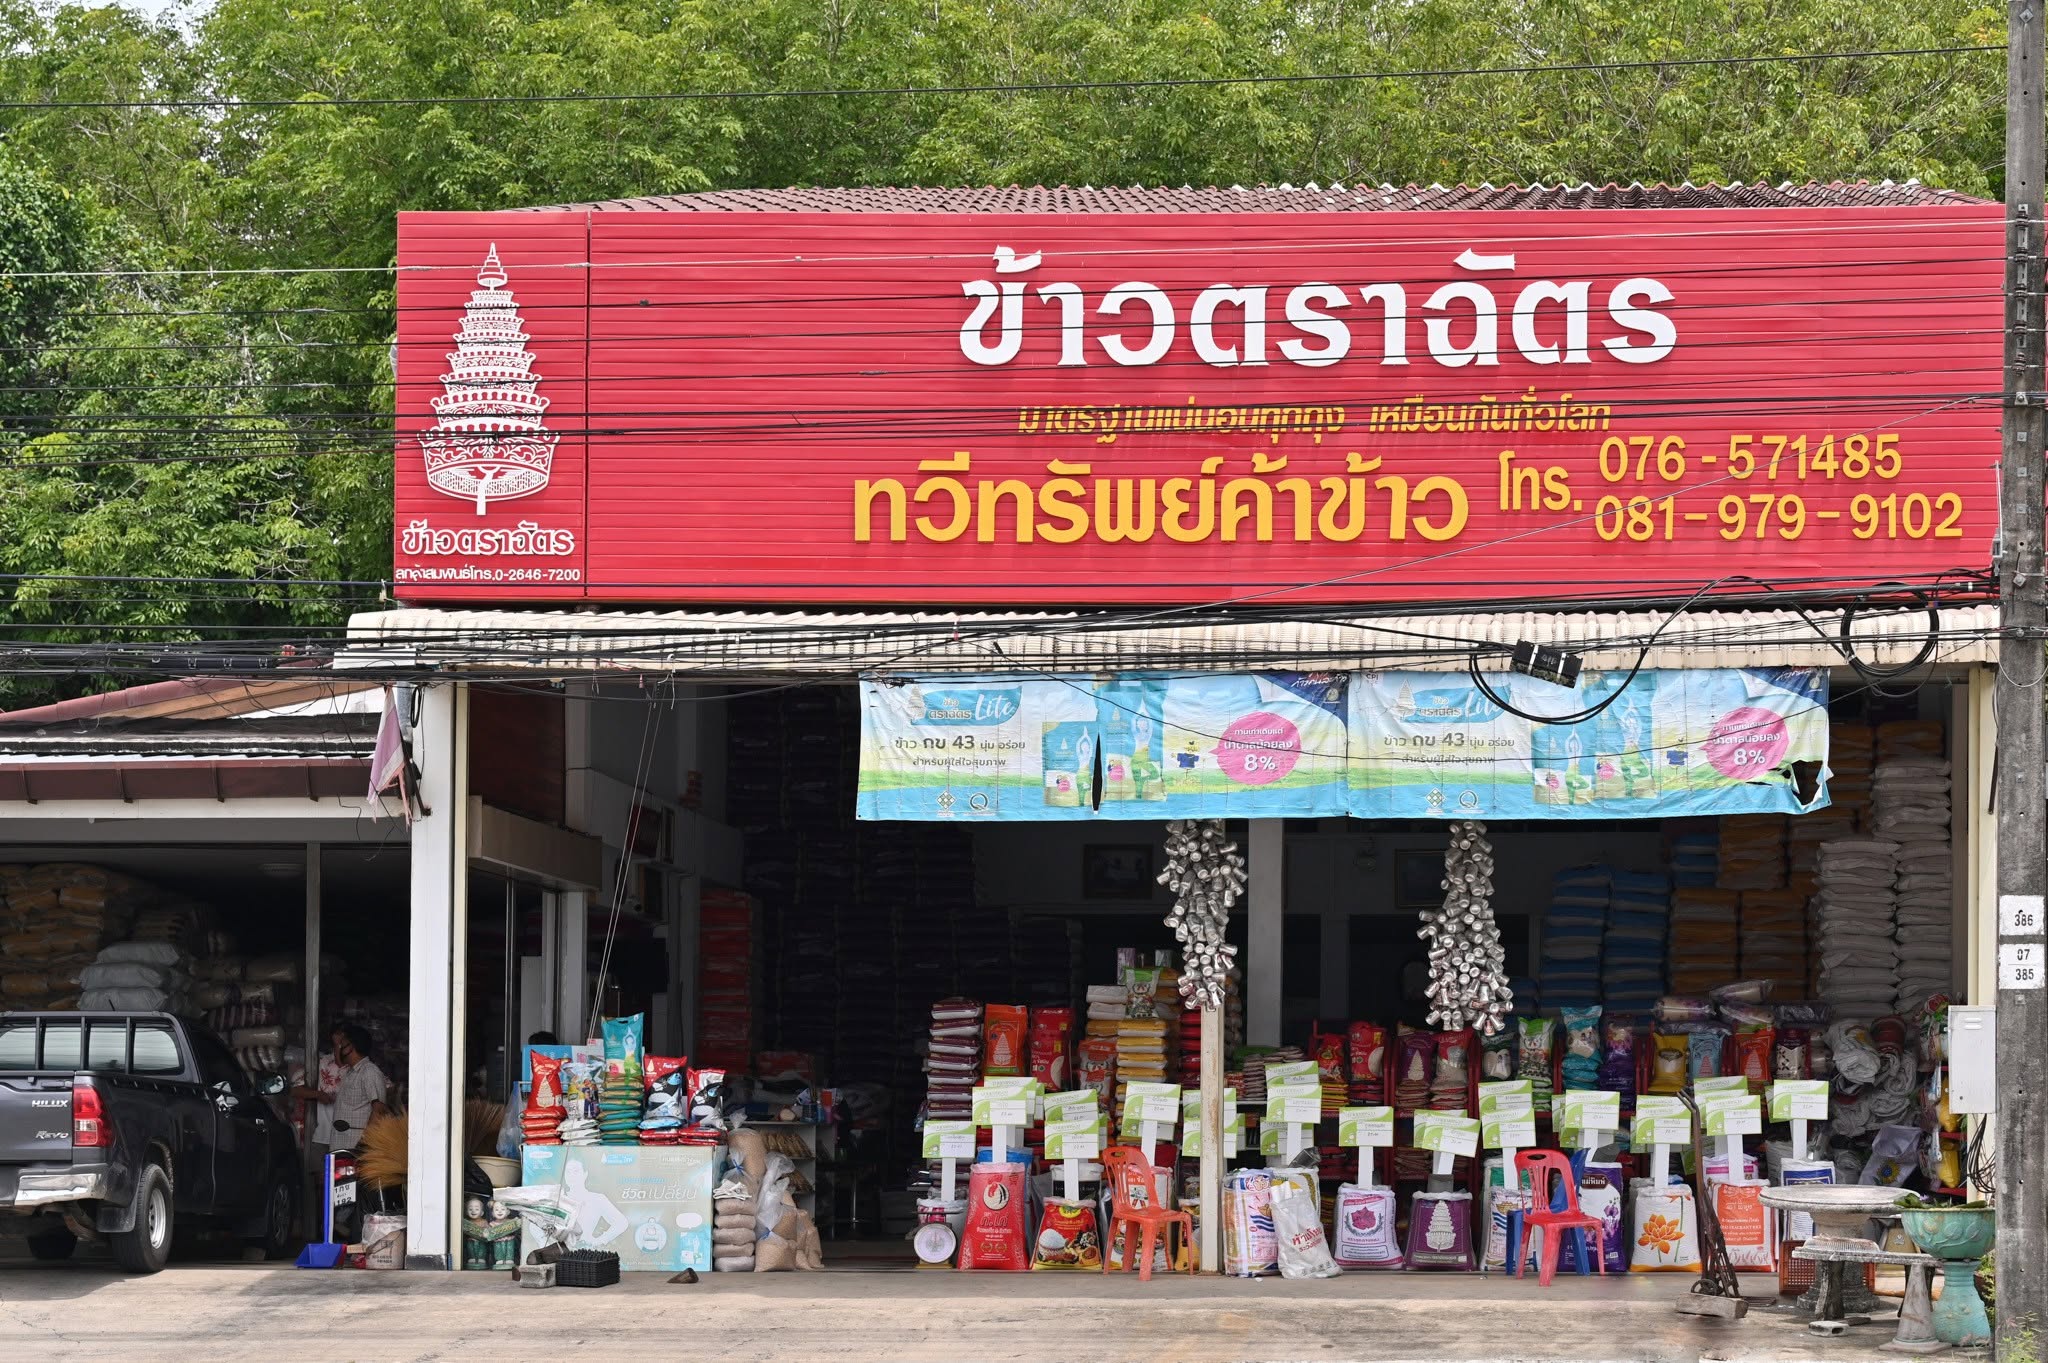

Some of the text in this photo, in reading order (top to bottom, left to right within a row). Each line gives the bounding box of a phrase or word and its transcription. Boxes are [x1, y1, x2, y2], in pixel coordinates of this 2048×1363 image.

[960, 246, 1677, 367] ข้าวตราฉัตร
[1018, 386, 1611, 444] มาตรฐานแน่นอนทุกถุง เหมือนกันทั่วโลก
[1499, 450, 1582, 512] โทร.
[854, 452, 1469, 543] ทวีทรัพย์ค้าข้าว
[402, 519, 575, 556] ข้าวตราฉัตร
[975, 693, 1015, 721] Lite
[895, 735, 1026, 753] ข้าว กข 43 นุ่ม อร่อย
[1384, 732, 1515, 749] ข้าว กข 43 นุ่ม อร่อย
[913, 756, 1006, 769] สำหรับผู้ใส่ใจสุขภาพ
[1244, 754, 1277, 772] 8%
[1733, 749, 1766, 765] 8%
[2014, 914, 2034, 927] 386
[2017, 948, 2031, 961] 07
[2015, 968, 2034, 981] 385
[32, 1099, 69, 1108] HILUX
